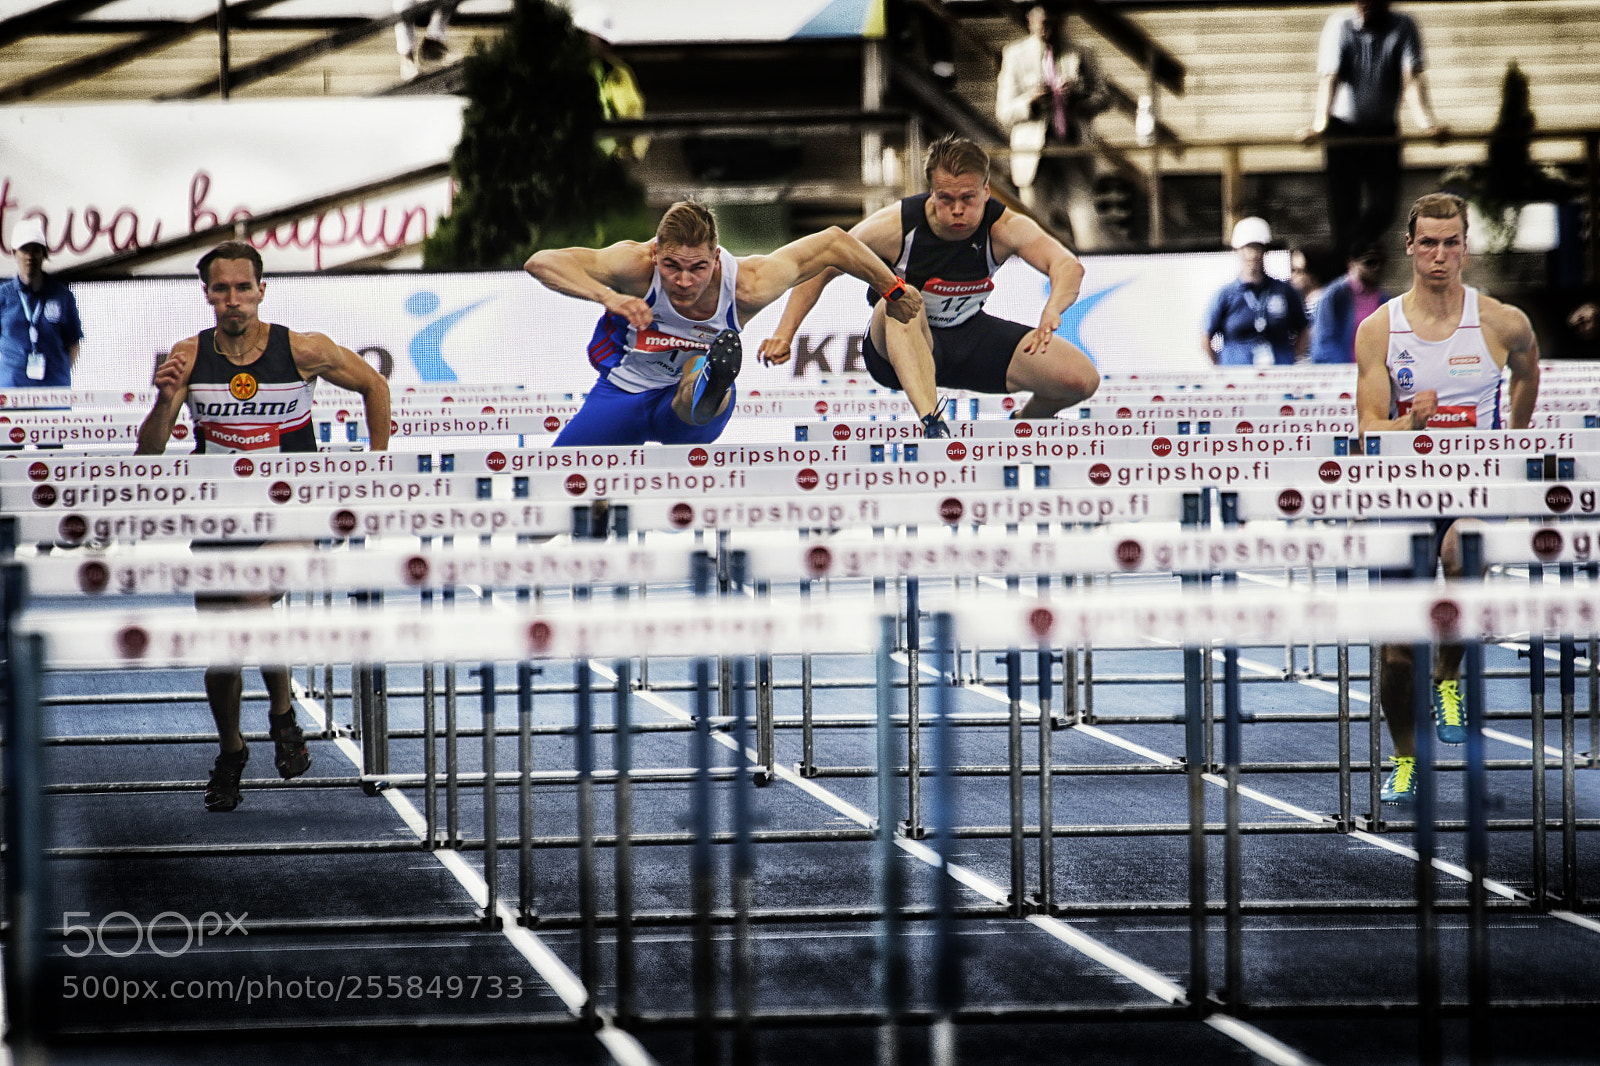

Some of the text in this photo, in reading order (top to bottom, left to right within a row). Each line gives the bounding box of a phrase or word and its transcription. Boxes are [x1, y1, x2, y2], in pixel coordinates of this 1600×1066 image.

[933, 281, 989, 293] motonet
[940, 295, 972, 313] 17
[832, 400, 911, 414] gripshop
[211, 430, 271, 445] motonet
[402, 418, 510, 436] gripshop.fi
[1037, 421, 1156, 437] gripshop.fi
[972, 440, 1105, 461] gripshop.fi
[1177, 435, 1312, 457] gripshop.fi
[1438, 433, 1574, 454] gripshop.fi
[259, 455, 394, 477] gripshop.fi
[511, 449, 645, 470] gripshop.fi
[713, 445, 847, 467] gripshop.fi
[54, 459, 190, 482] gripshop.fi
[825, 466, 977, 490] gripshop.fi
[1117, 462, 1271, 486] gripshop.fi
[1348, 458, 1501, 484] gripshop.fi
[298, 479, 452, 504] gripshop.fi
[594, 470, 747, 496] gripshop.fi
[61, 482, 217, 508] gripshop.fi
[1310, 486, 1490, 516] gripshop.fi
[701, 500, 881, 529] gripshop.fi
[970, 492, 1149, 524] gripshop.fi
[93, 511, 277, 541] gripshop.fi
[363, 505, 546, 535] gripshop.fi
